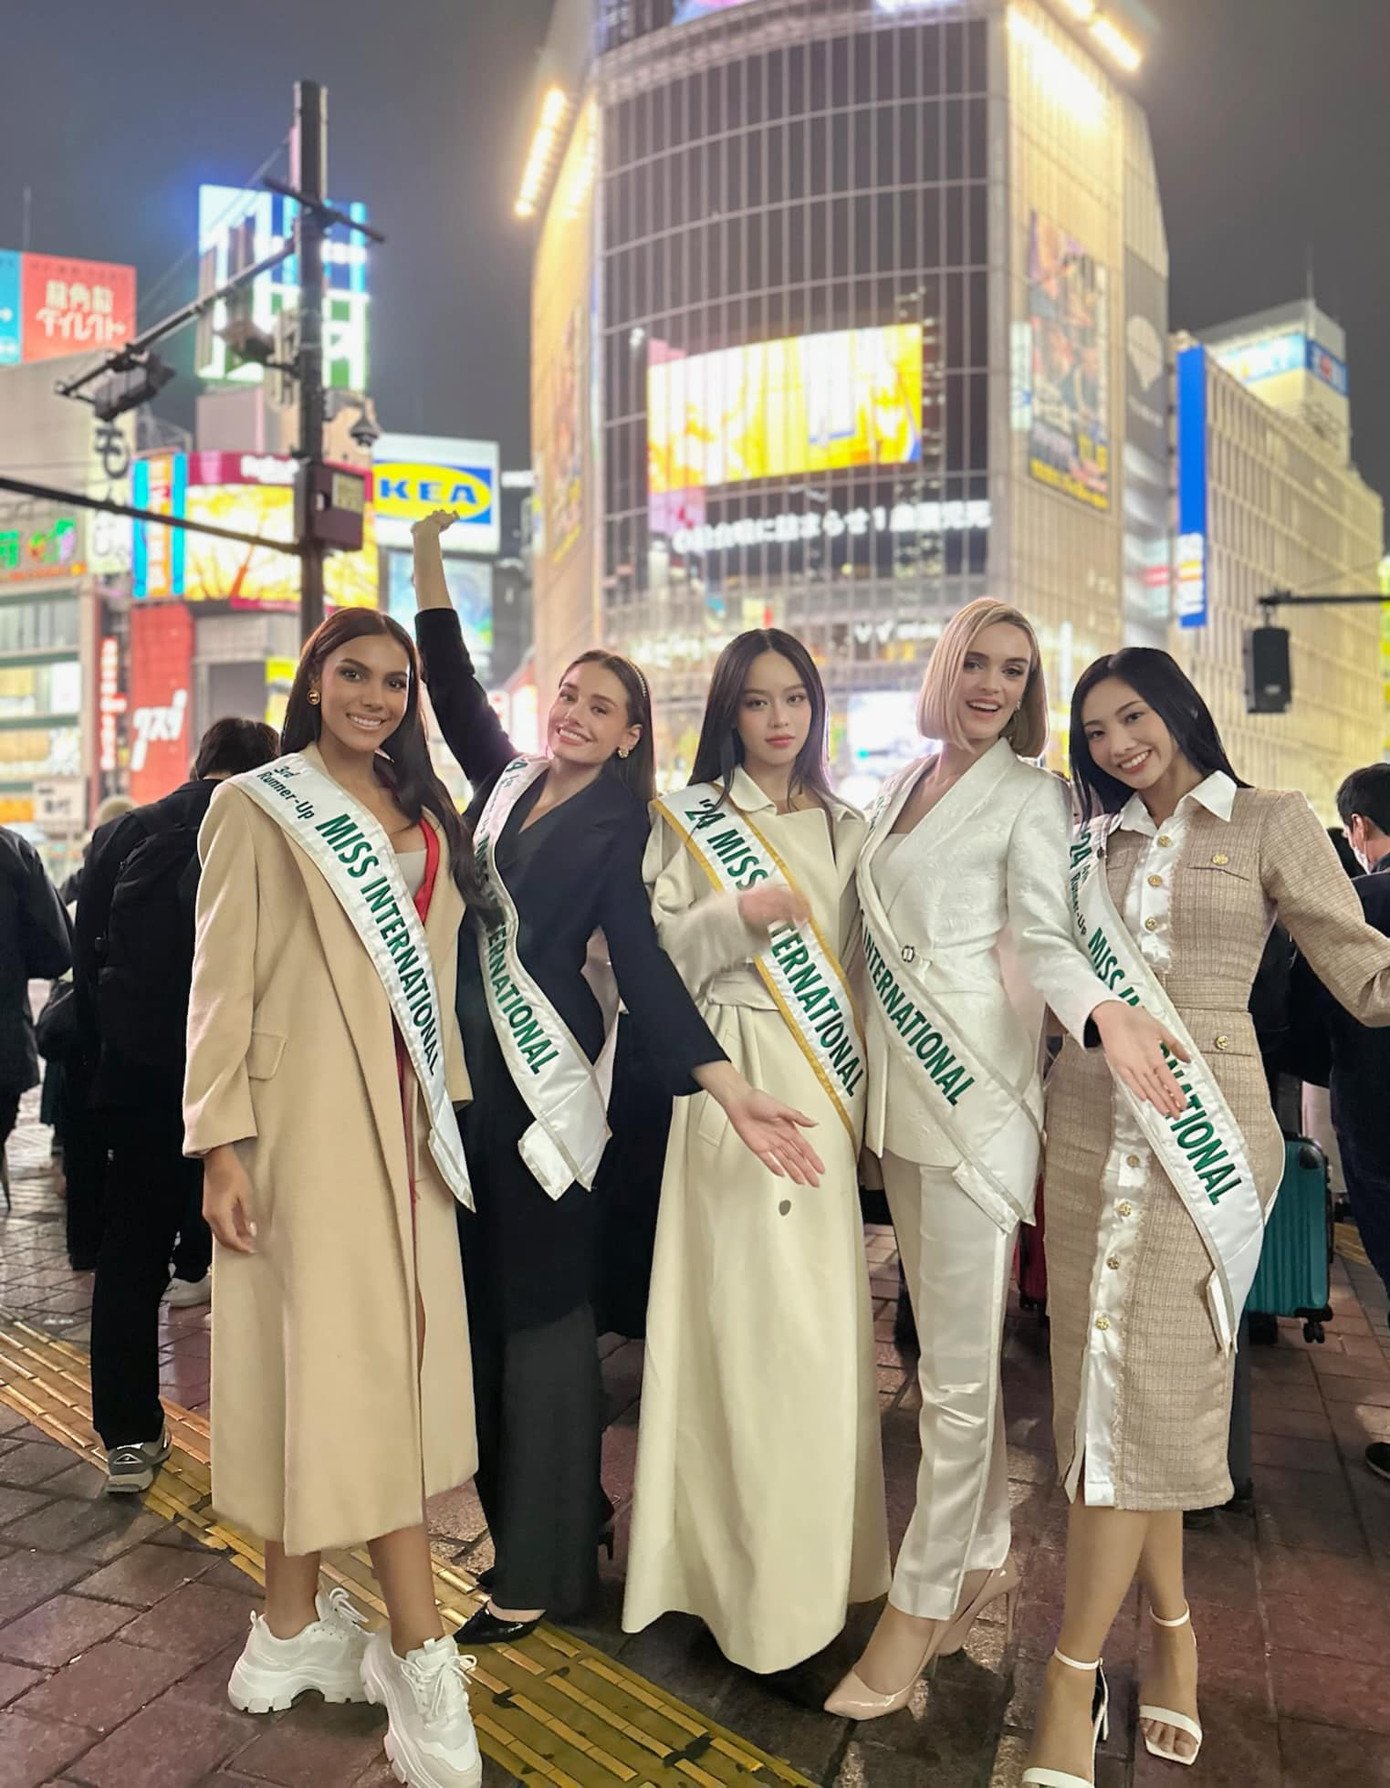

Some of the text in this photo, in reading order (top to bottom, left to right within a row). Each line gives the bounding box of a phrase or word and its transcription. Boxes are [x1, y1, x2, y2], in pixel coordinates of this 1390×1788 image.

[379, 478, 478, 506] KEA
[257, 771, 315, 820] Runner-Up
[273, 765, 300, 780] 3rd
[315, 813, 440, 1077] MISS INTERNATIONAL
[487, 921, 560, 1076] ERNATIONAL
[707, 829, 768, 891] MISS
[771, 922, 865, 1098] TERNATIONAL
[1088, 927, 1125, 991] MISS
[863, 925, 975, 1107] INTERNATIONAL
